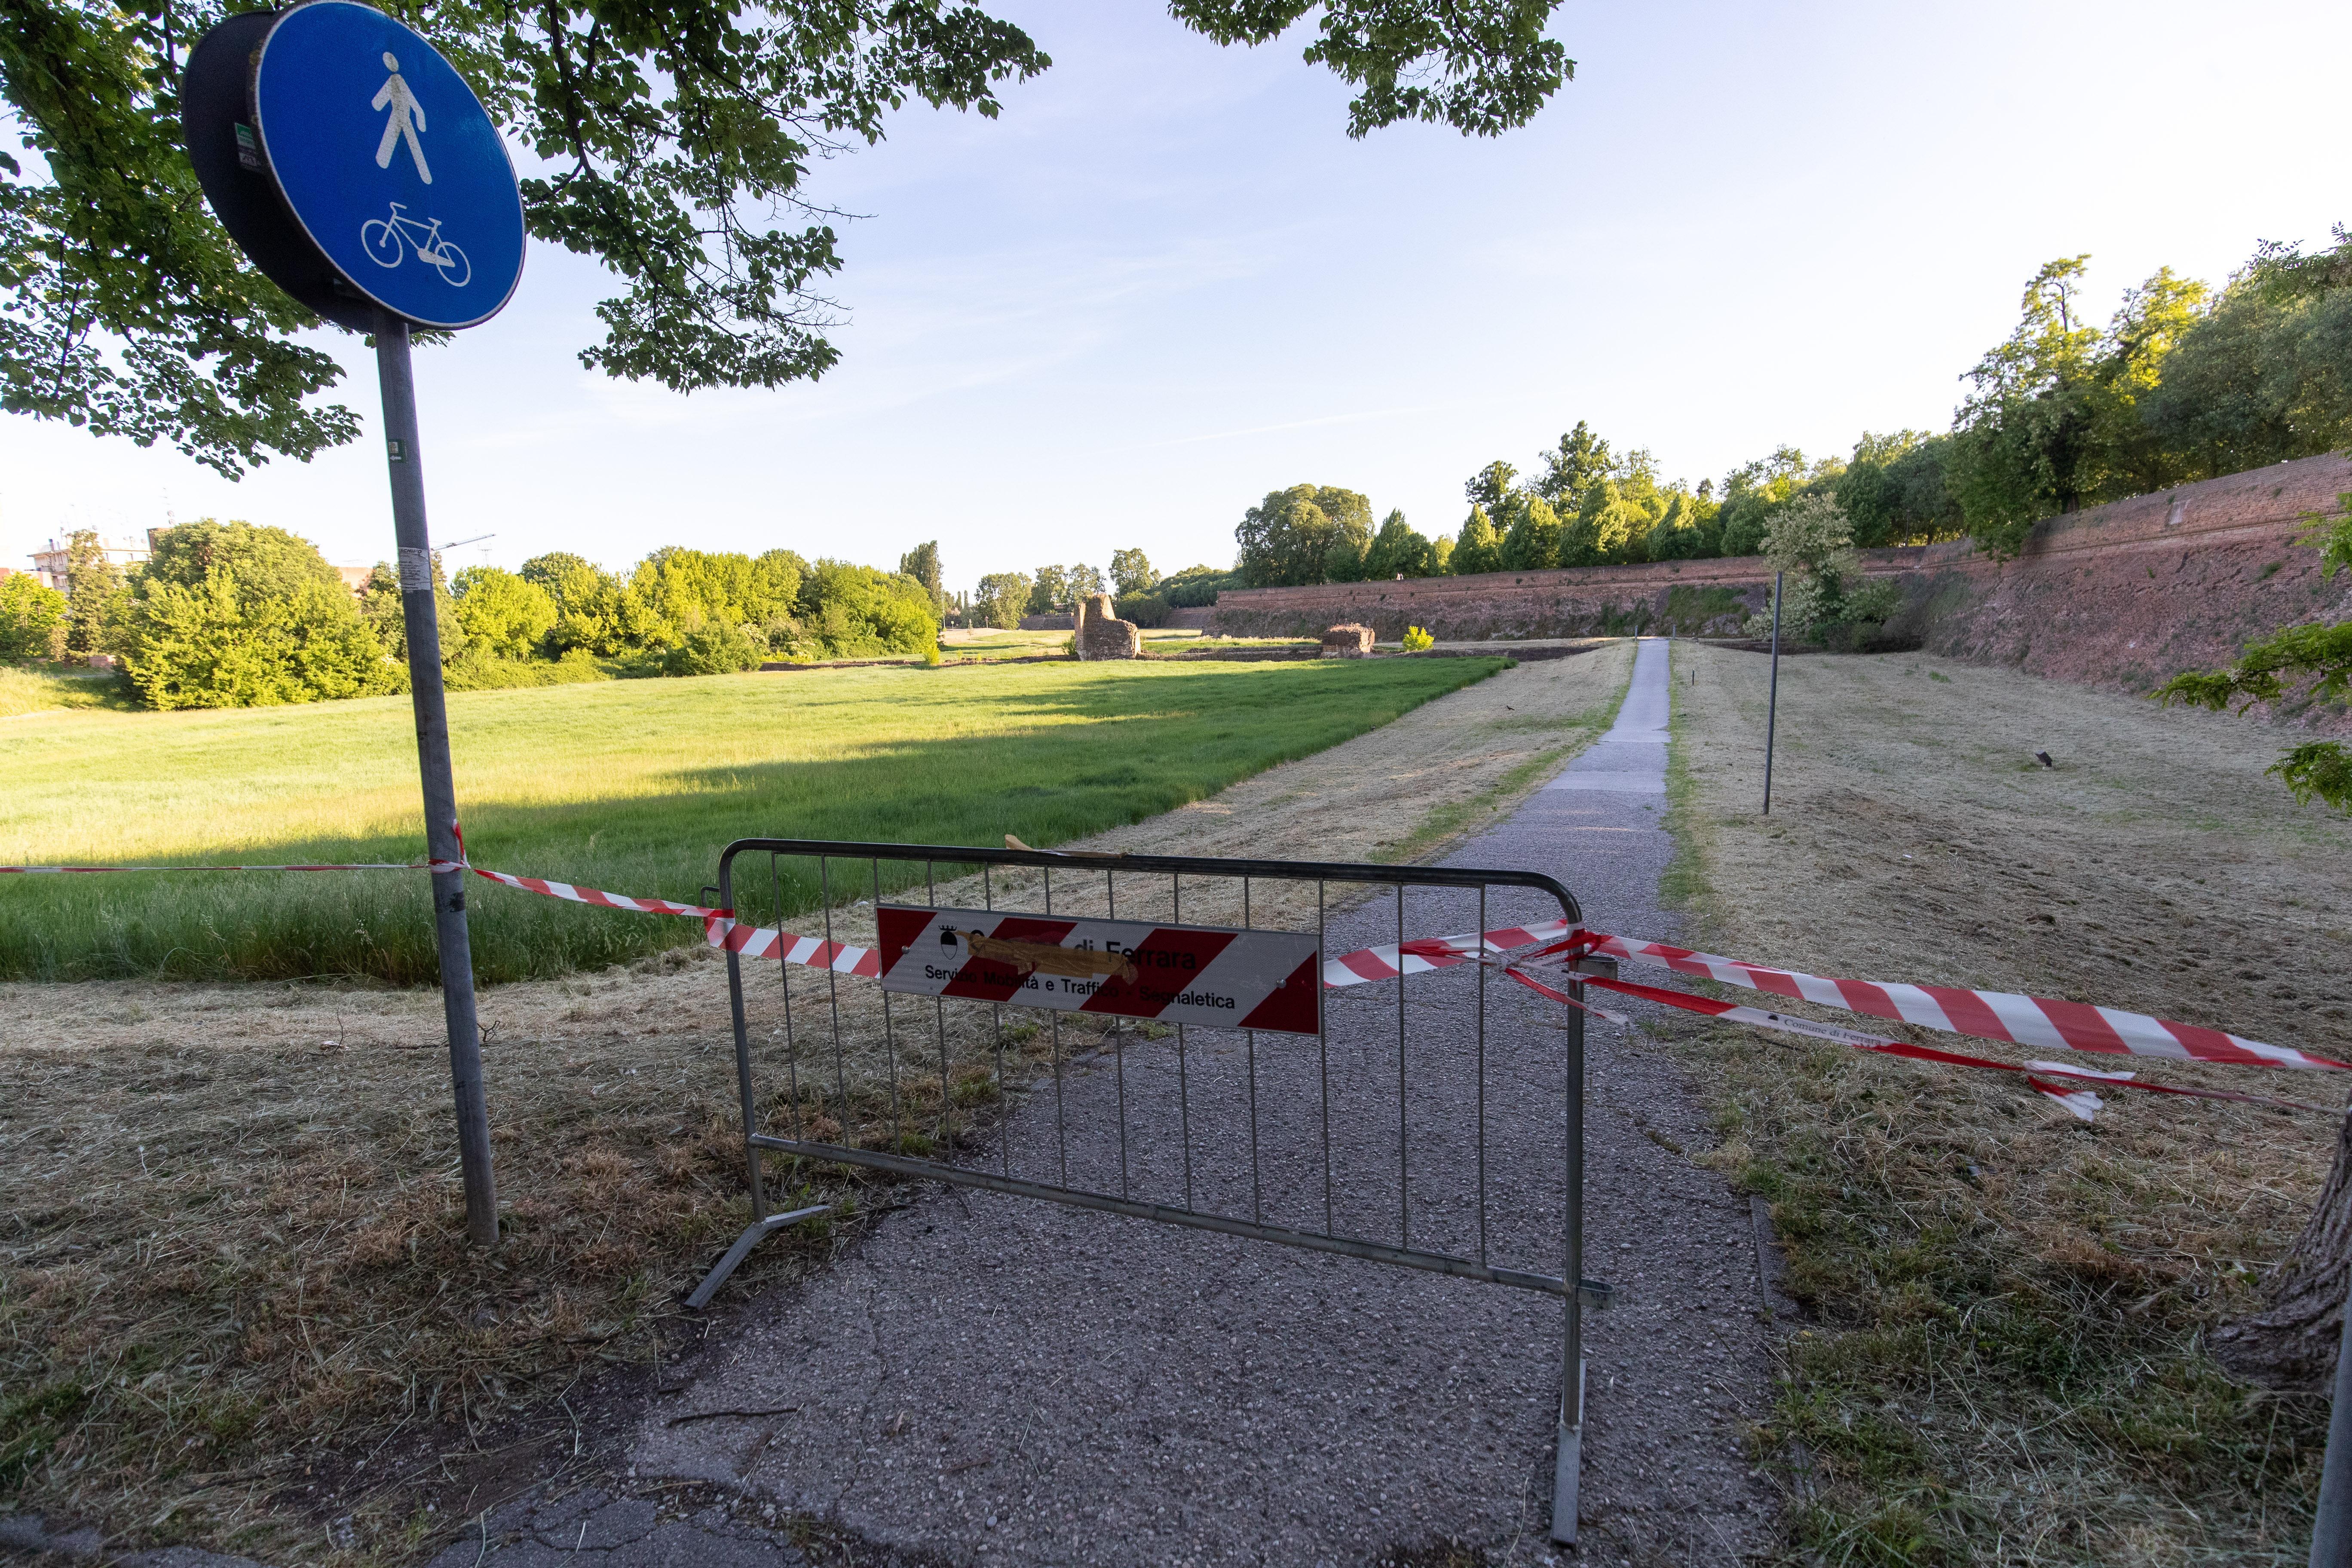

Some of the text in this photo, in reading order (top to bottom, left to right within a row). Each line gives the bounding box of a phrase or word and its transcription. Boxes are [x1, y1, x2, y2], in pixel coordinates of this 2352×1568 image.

[1106, 941, 1196, 970] Ferrara
[925, 965, 977, 983] Servizio
[983, 971, 1039, 990] Mobilità
[1046, 980, 1055, 991] e
[1061, 978, 1120, 998] Traffico
[1139, 985, 1236, 1010] Segnaletica
[1784, 1019, 1827, 1034] Comune
[1829, 1028, 1840, 1037] di
[1842, 1032, 1882, 1045] Ferrara
